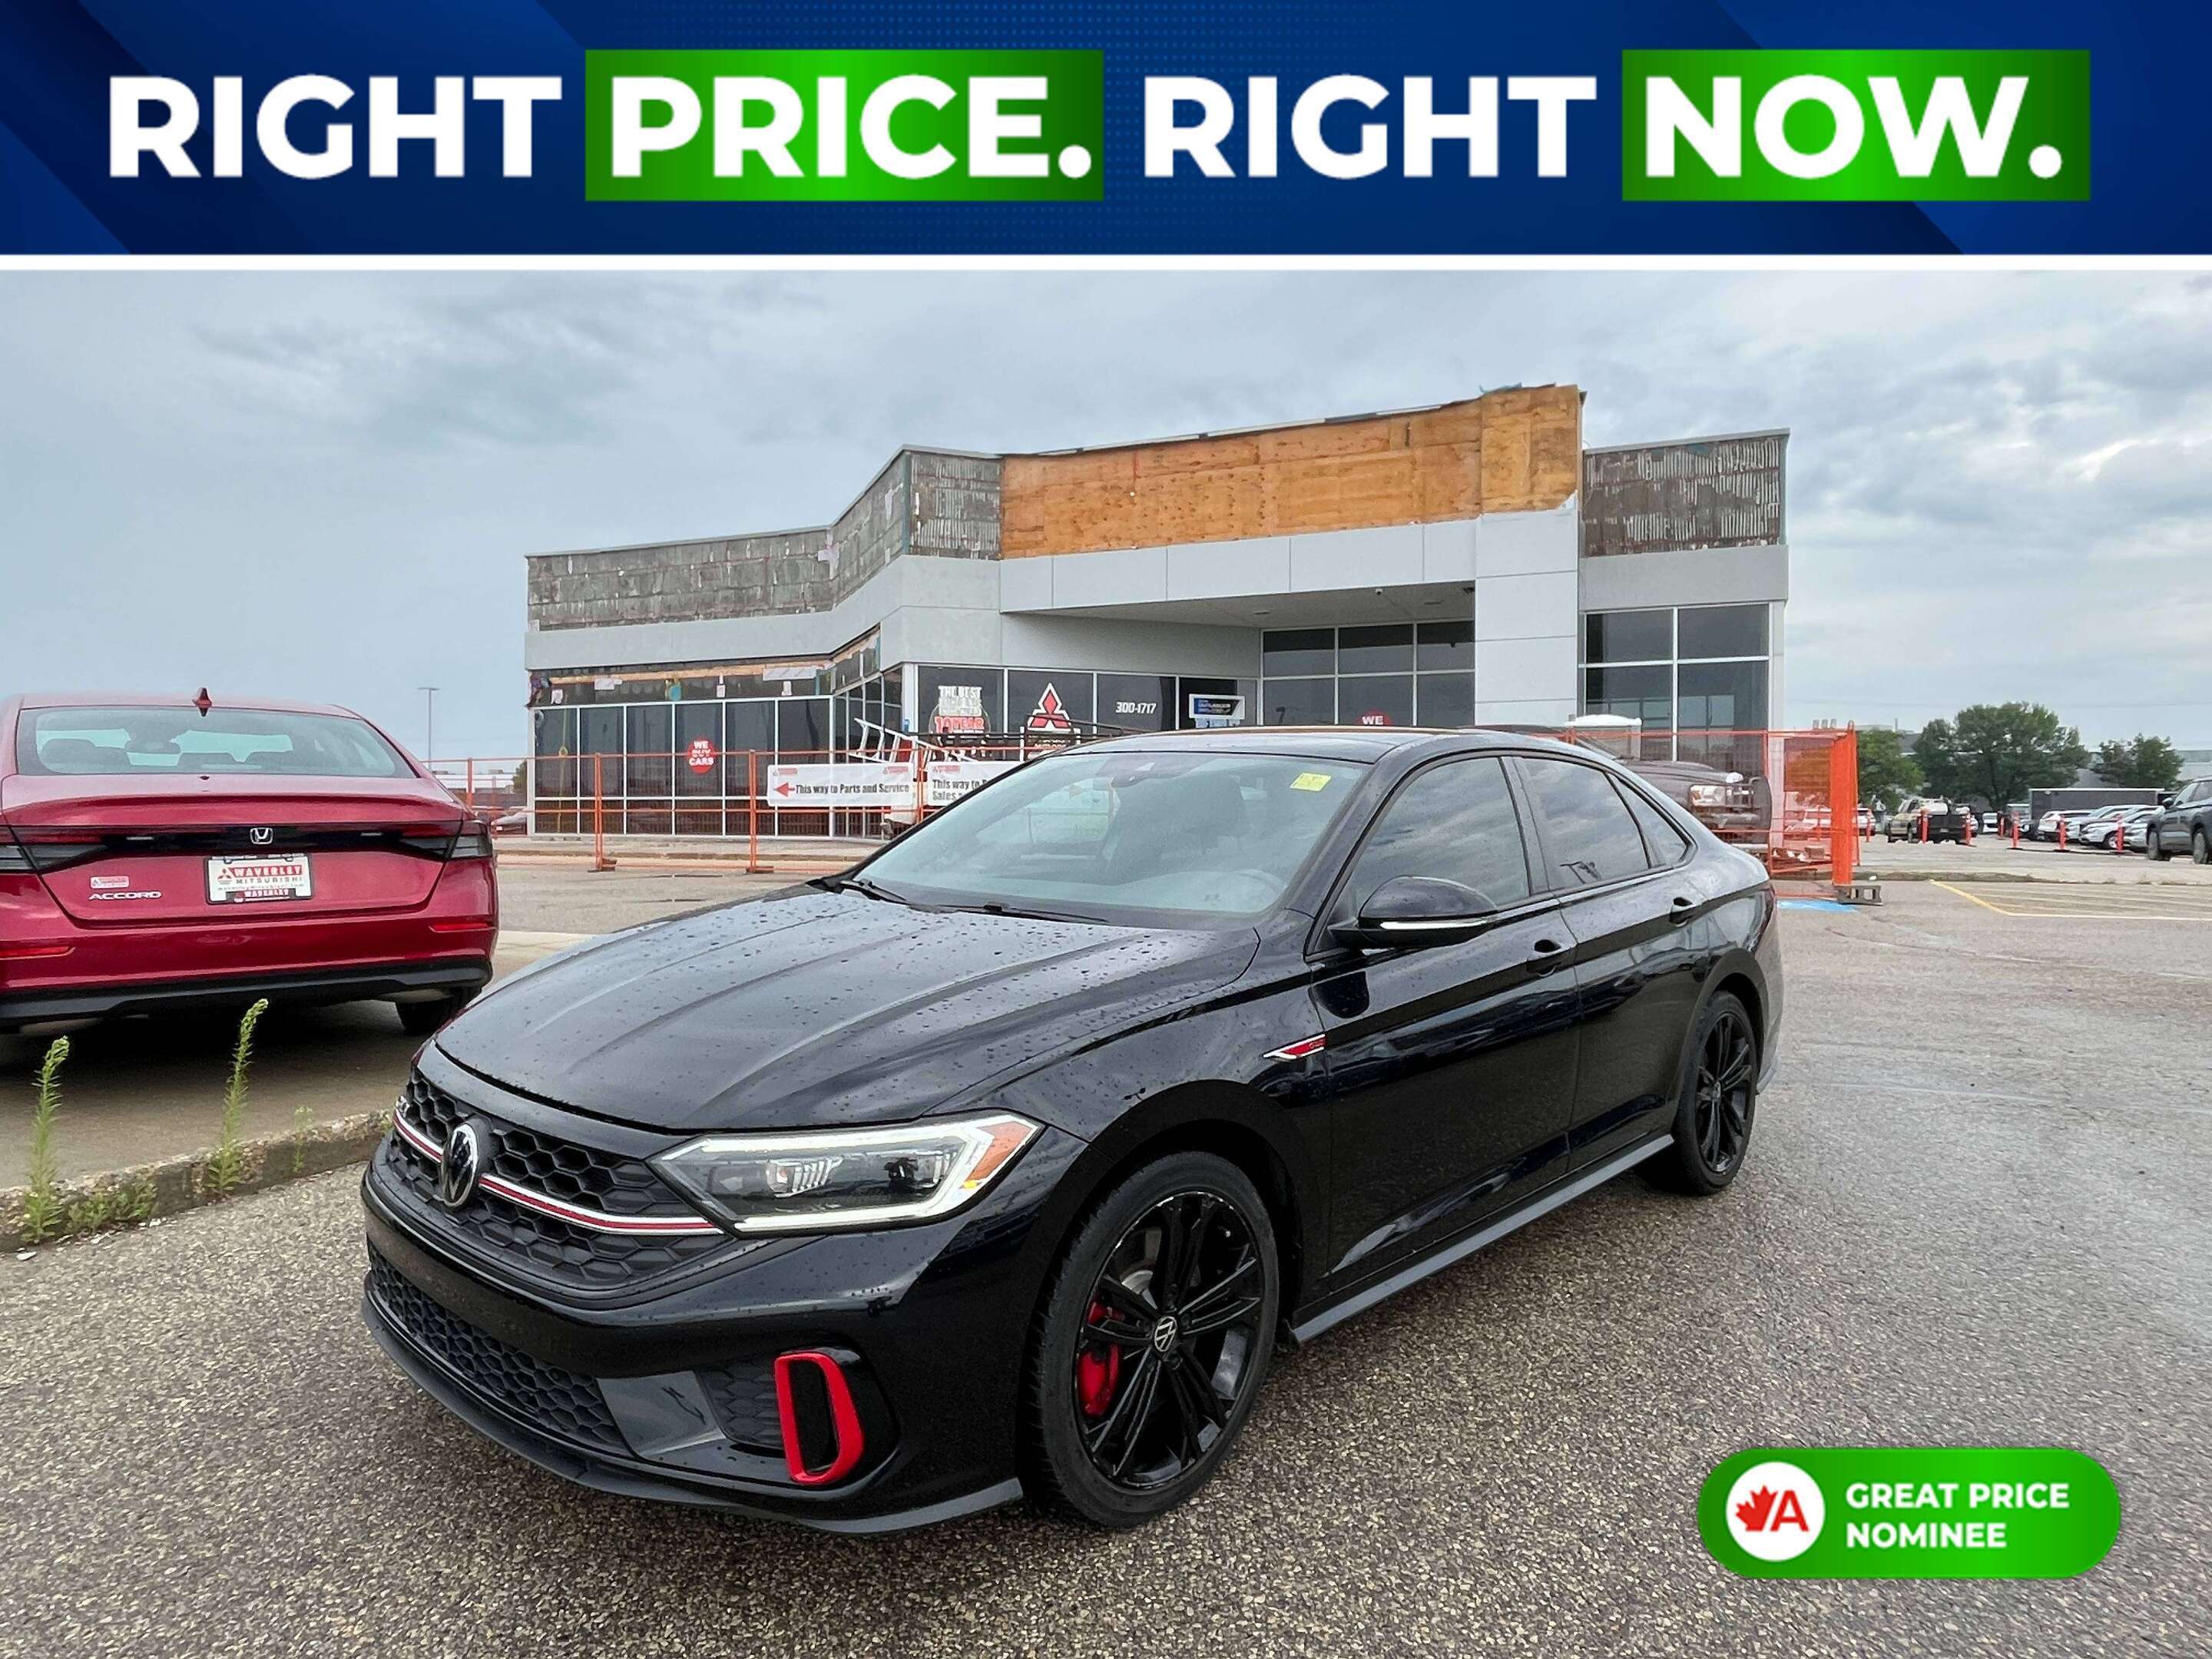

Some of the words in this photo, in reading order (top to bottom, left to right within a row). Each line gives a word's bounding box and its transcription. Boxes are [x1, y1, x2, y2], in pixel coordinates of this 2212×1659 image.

[938, 686, 957, 697] THE
[959, 686, 982, 698] BEST
[1115, 701, 1157, 714] 300-1717
[953, 717, 985, 730] YEAR
[1362, 715, 1383, 725] WE
[694, 740, 709, 749] WE
[691, 749, 711, 757] BUY
[688, 757, 714, 766] CARS
[796, 784, 812, 794] This
[813, 785, 829, 795] way
[830, 784, 838, 793] to
[840, 783, 860, 793] Parts
[862, 783, 877, 793] and
[879, 783, 909, 793] Service
[932, 779, 951, 790] This
[952, 781, 969, 790] way
[971, 780, 980, 789] to
[932, 790, 957, 801] Sales
[233, 866, 302, 878] WAVERLEY
[236, 876, 303, 885] MITSUBISHI
[88, 891, 162, 900] ACCORD
[244, 889, 290, 898] WAVERLEY
